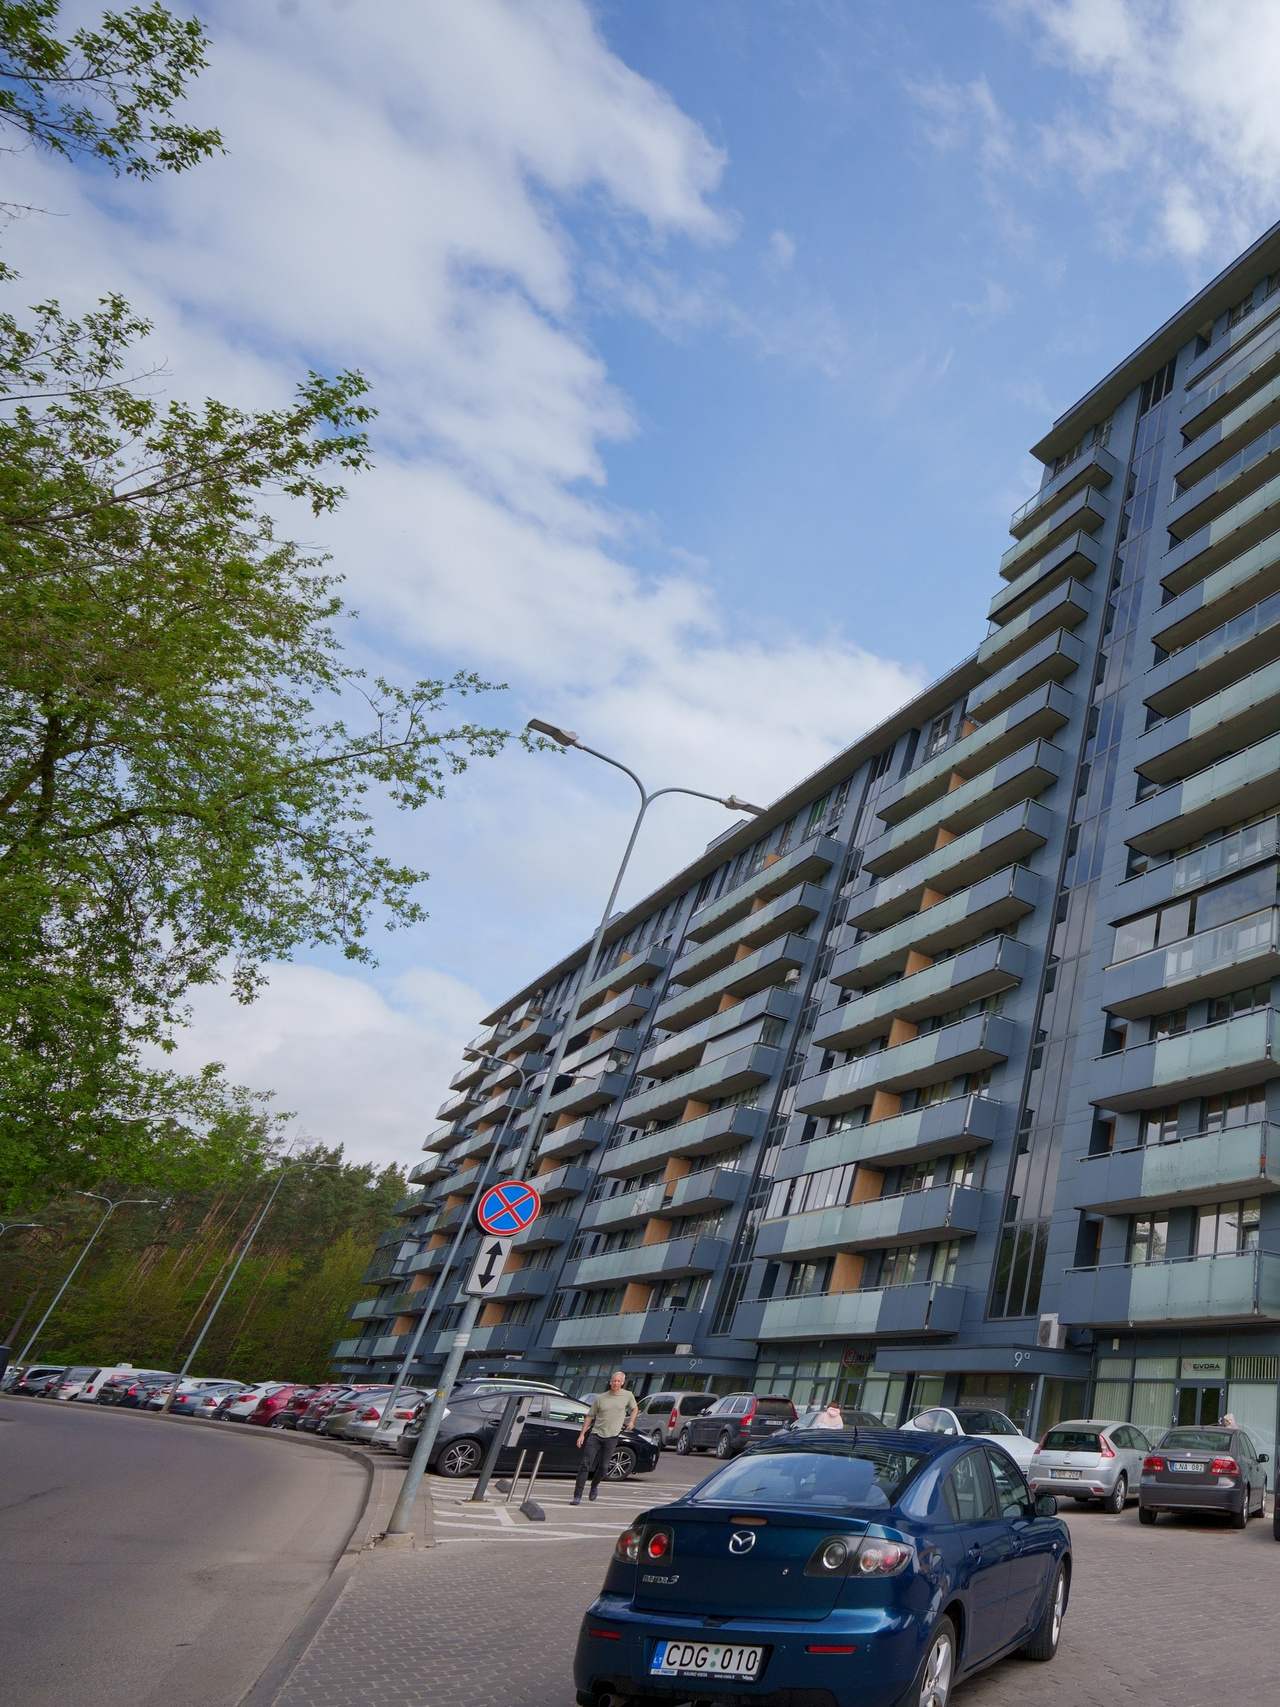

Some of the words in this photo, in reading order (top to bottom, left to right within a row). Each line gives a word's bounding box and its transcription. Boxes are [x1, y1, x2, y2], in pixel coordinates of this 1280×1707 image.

[1174, 1463, 1188, 1471] LNA
[653, 1656, 663, 1664] LT
[666, 1644, 709, 1668] CDG
[720, 1648, 758, 1671] 010
